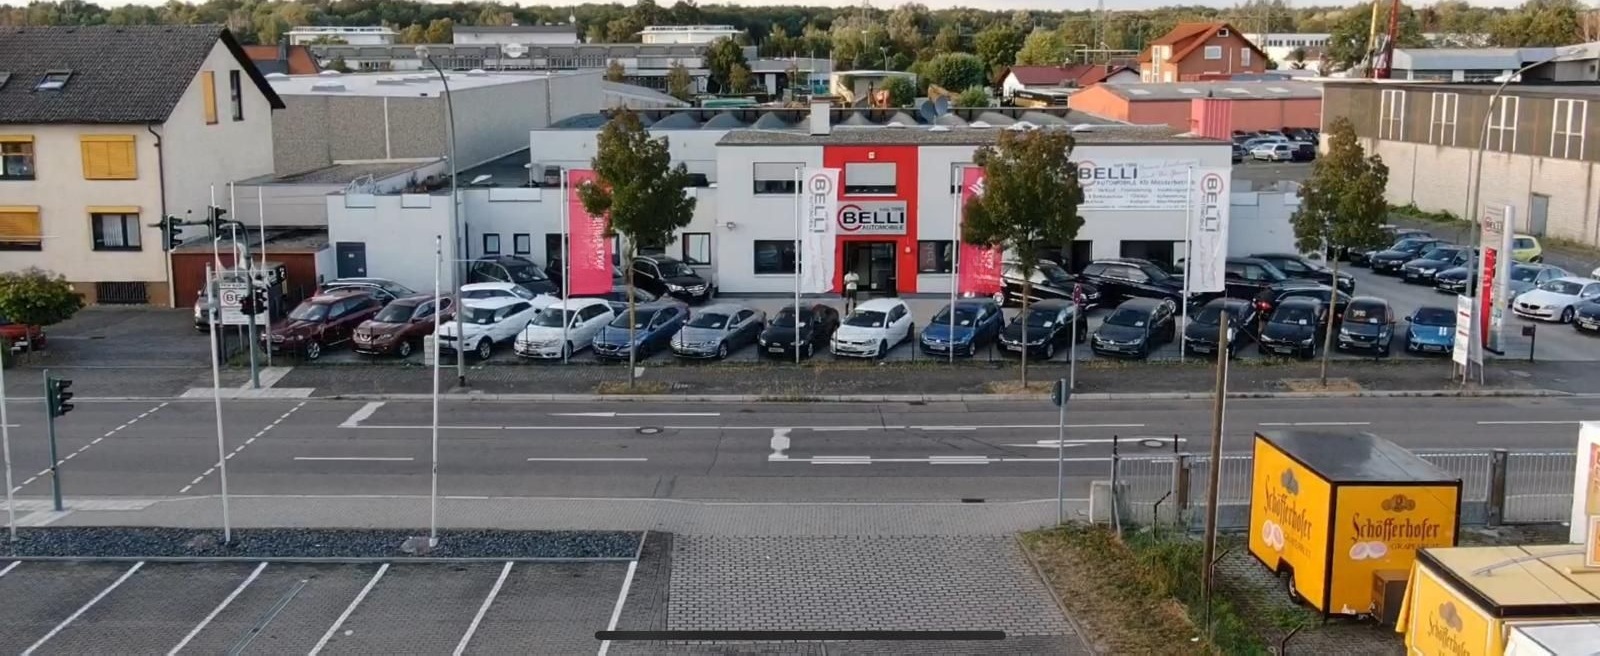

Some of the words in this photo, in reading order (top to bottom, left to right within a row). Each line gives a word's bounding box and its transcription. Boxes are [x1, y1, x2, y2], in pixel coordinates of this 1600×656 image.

[1079, 167, 1138, 180] BELLI
[813, 178, 826, 234] BELLI
[843, 211, 905, 224] BELLI
[1205, 178, 1218, 232] BELLI
[1350, 511, 1440, 542] Schöfferhofer
